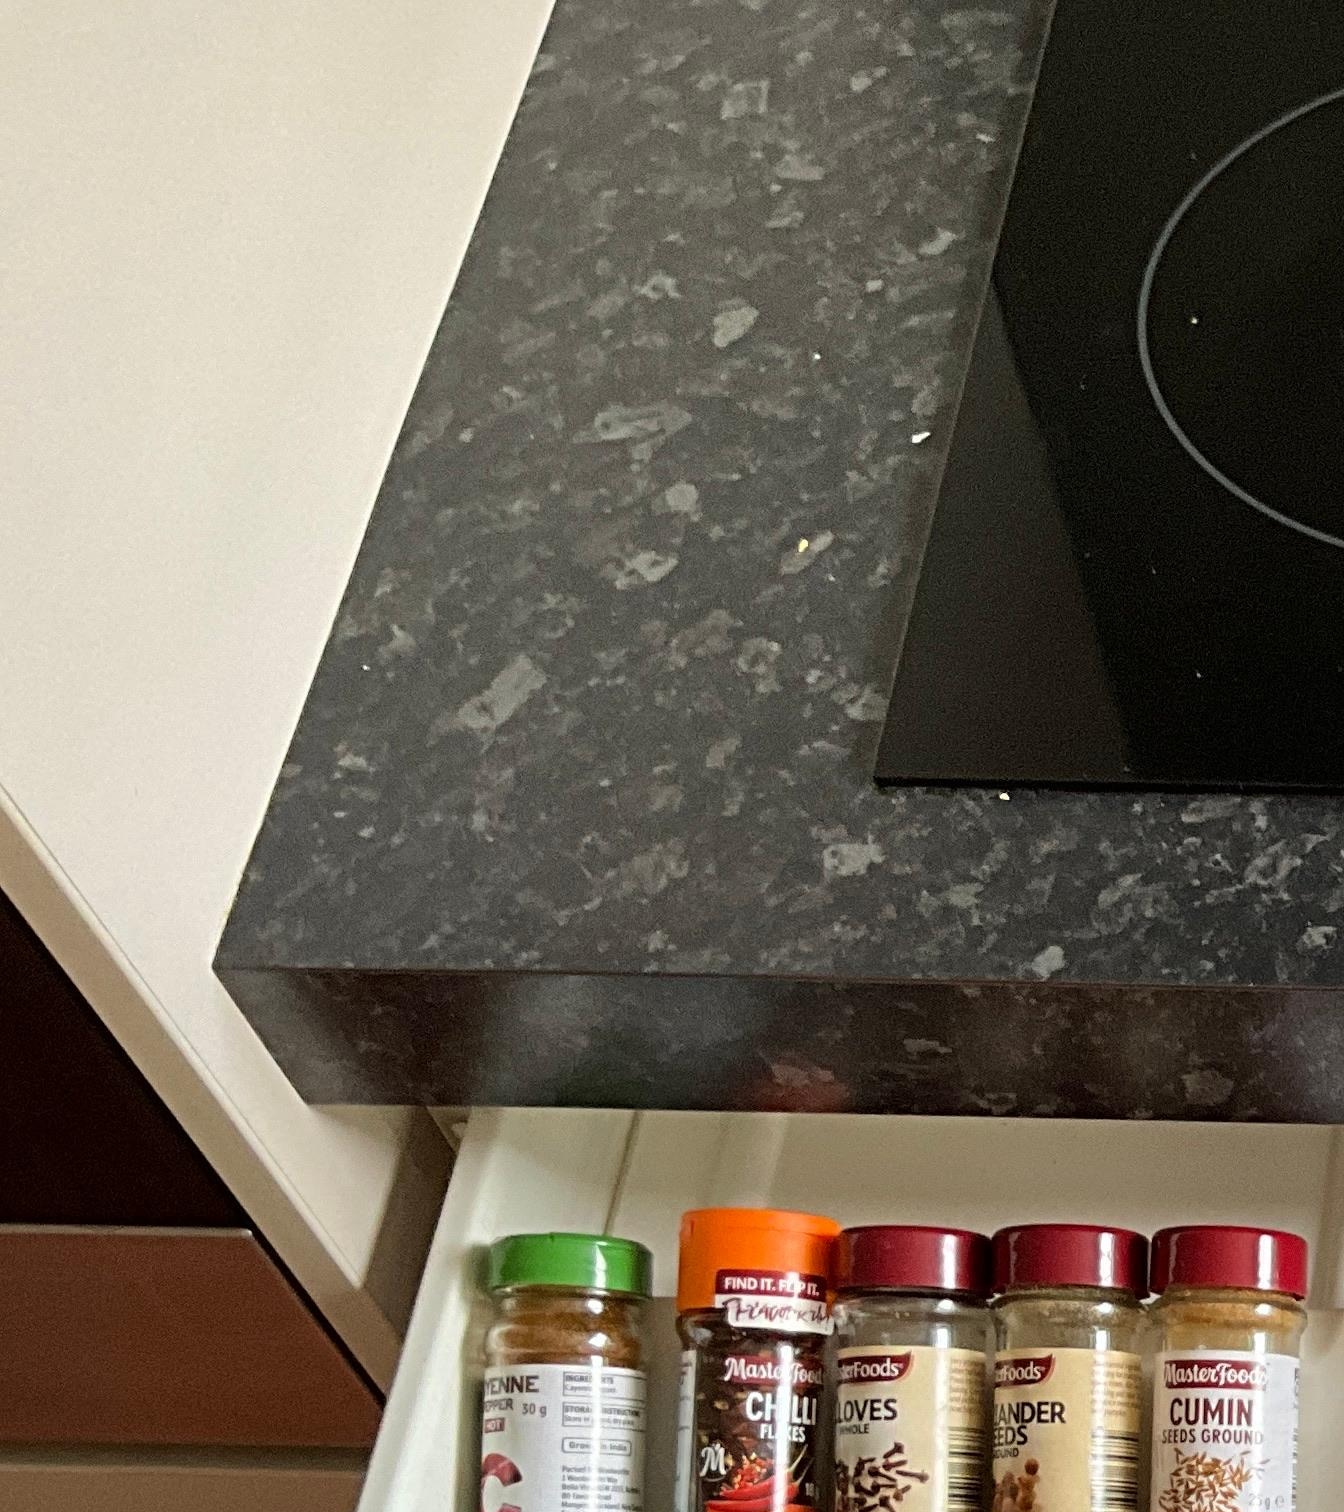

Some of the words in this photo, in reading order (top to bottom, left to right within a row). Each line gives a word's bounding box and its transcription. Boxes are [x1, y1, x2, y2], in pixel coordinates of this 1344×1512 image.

[724, 1277, 758, 1291] FIND
[761, 1278, 777, 1291] IT.
[779, 1278, 806, 1293] FLP
[807, 1282, 820, 1296] IT.
[1164, 1362, 1269, 1386] MasterFoods
[522, 1402, 536, 1416] 30
[539, 1406, 547, 1418] g
[745, 1390, 817, 1426] CHLLI
[1170, 1397, 1253, 1427] CUMIN
[760, 1423, 806, 1443] FLKES
[1162, 1428, 1196, 1444] SEEDS
[1201, 1428, 1264, 1445] GROUND
